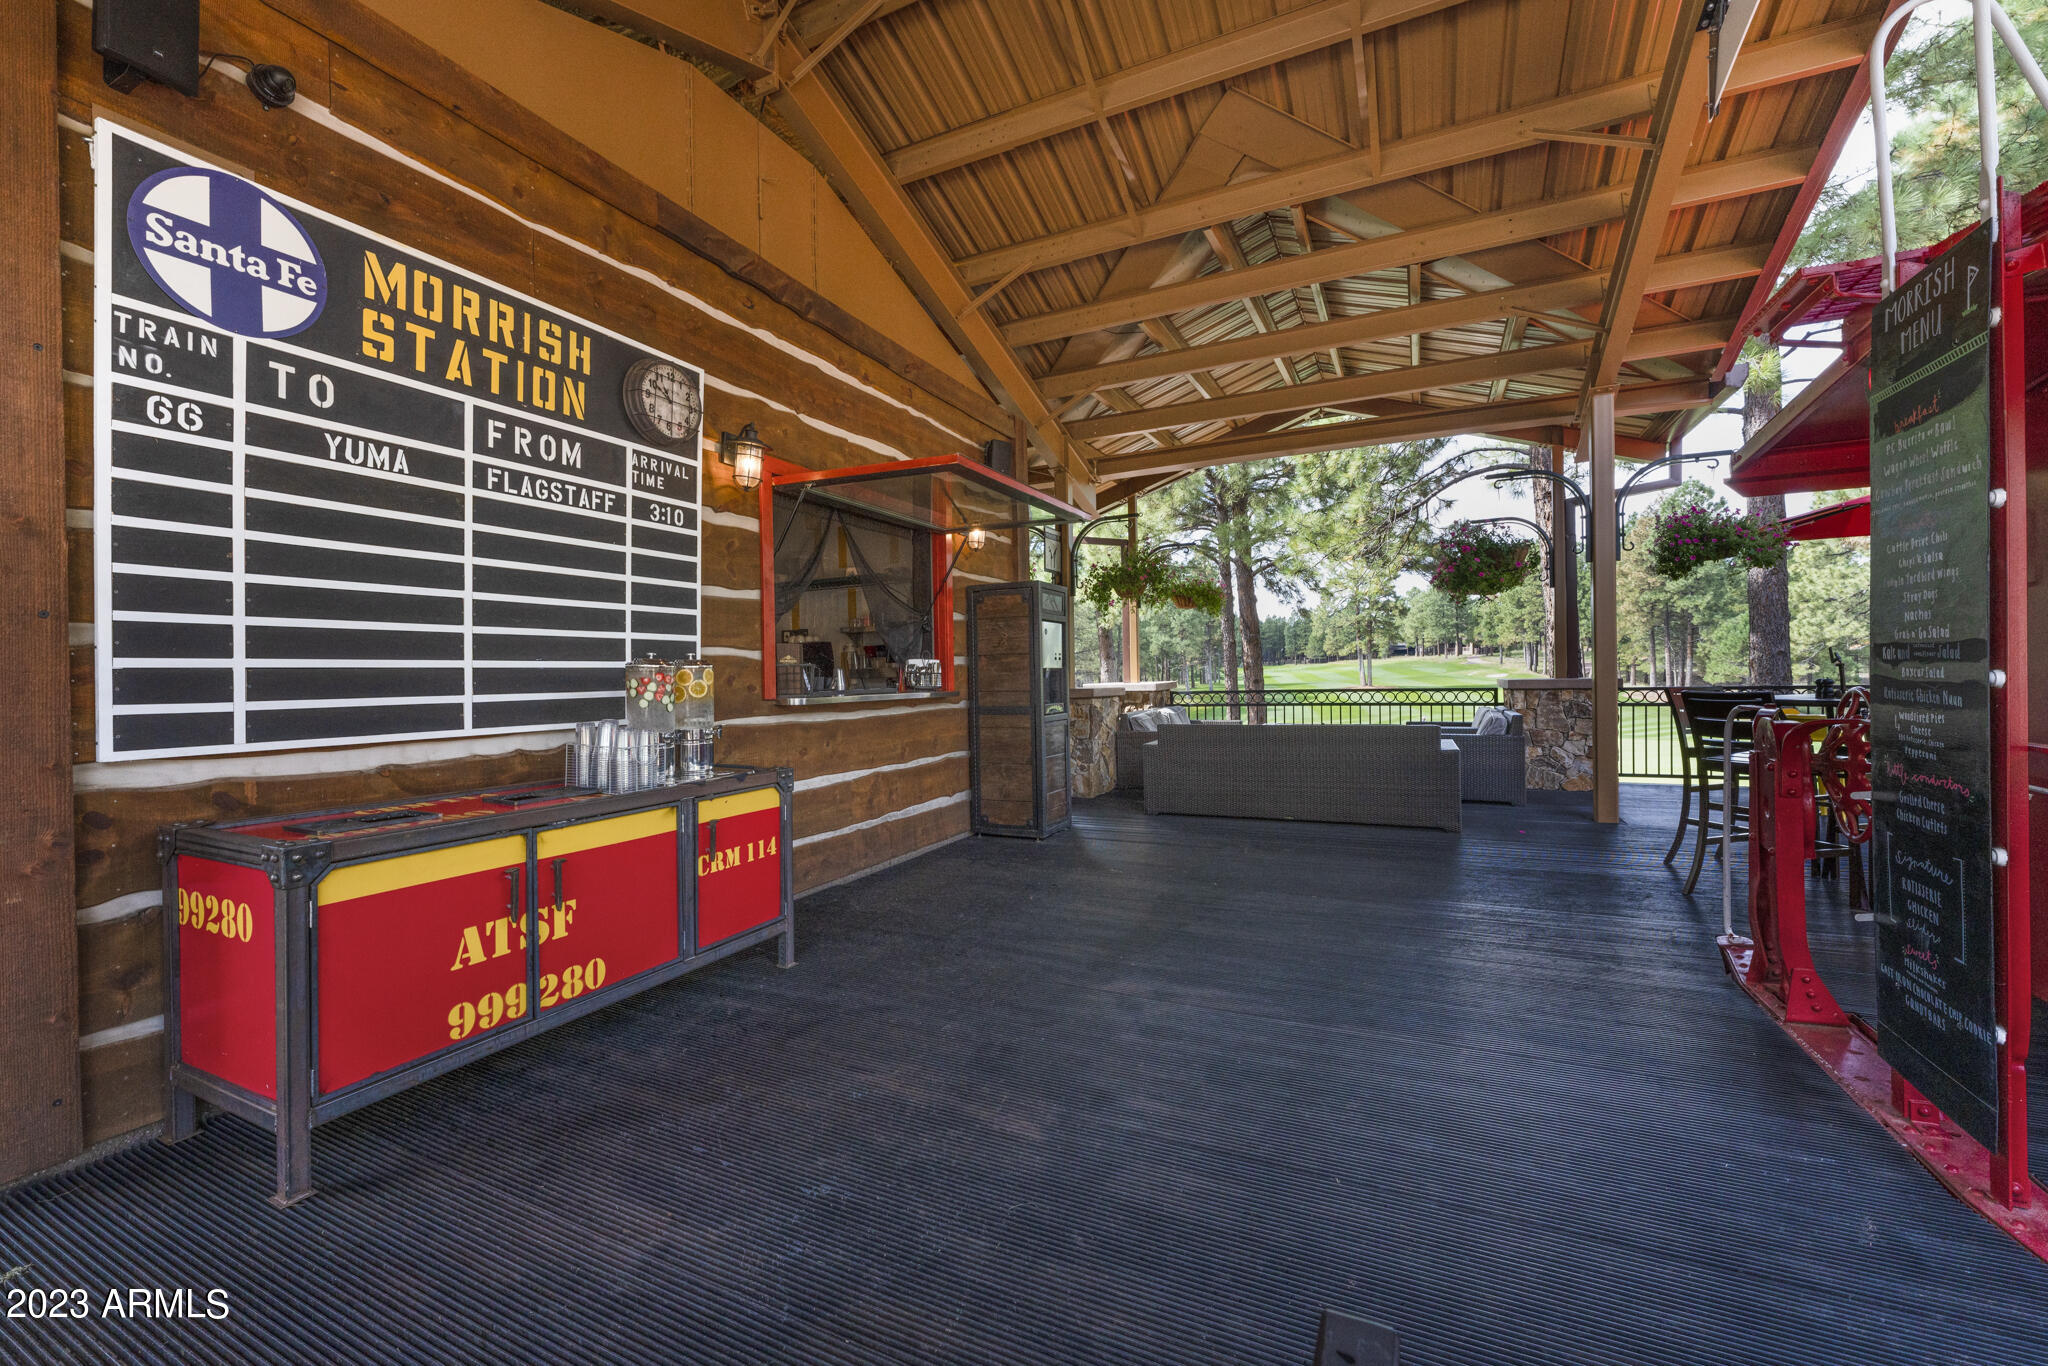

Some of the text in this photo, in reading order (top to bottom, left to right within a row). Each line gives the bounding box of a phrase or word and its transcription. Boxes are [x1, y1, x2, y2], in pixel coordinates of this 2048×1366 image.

[145, 212, 317, 296] Santa Fe
[364, 250, 591, 376] MORRISH
[1884, 256, 1955, 333] MORRISH
[114, 310, 217, 358] TRAIN
[1901, 304, 1942, 355] MENU
[118, 345, 172, 378] NO.
[268, 360, 335, 409] TO
[362, 307, 585, 421] STATION
[324, 432, 409, 475] YUMA
[488, 419, 581, 469] FROM
[632, 453, 689, 480] ARRIVAL
[487, 467, 616, 512] FLAGSTAFF
[632, 470, 665, 490] TIME
[650, 503, 684, 527] 3:10
[698, 836, 777, 877] CRM 114
[450, 898, 577, 971] ATSF
[447, 957, 606, 1040] 999280
